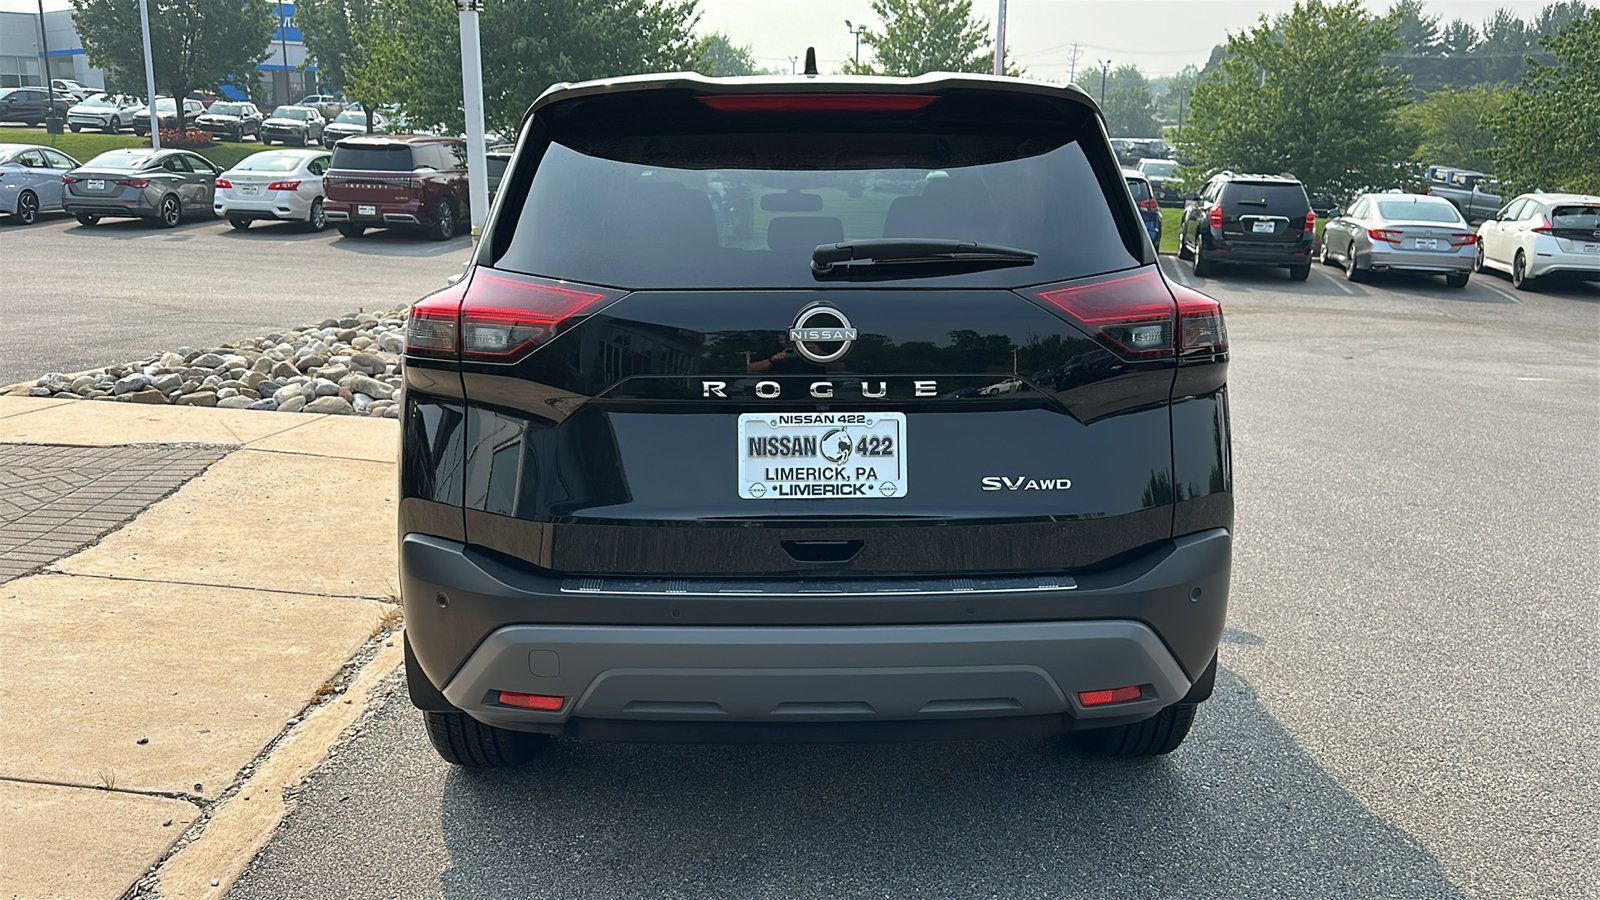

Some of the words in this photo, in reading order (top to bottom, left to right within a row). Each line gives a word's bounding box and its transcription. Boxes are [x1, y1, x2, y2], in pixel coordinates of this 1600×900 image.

[791, 330, 856, 339] NISSAN
[702, 380, 938, 399] ROGUE
[779, 415, 834, 424] NISSAN
[837, 415, 866, 423] 422
[748, 436, 817, 458] NISSAN
[855, 436, 894, 457] 422
[765, 467, 850, 481] LIMERICK,
[856, 467, 878, 480] PA
[779, 483, 866, 496] LIMERICK
